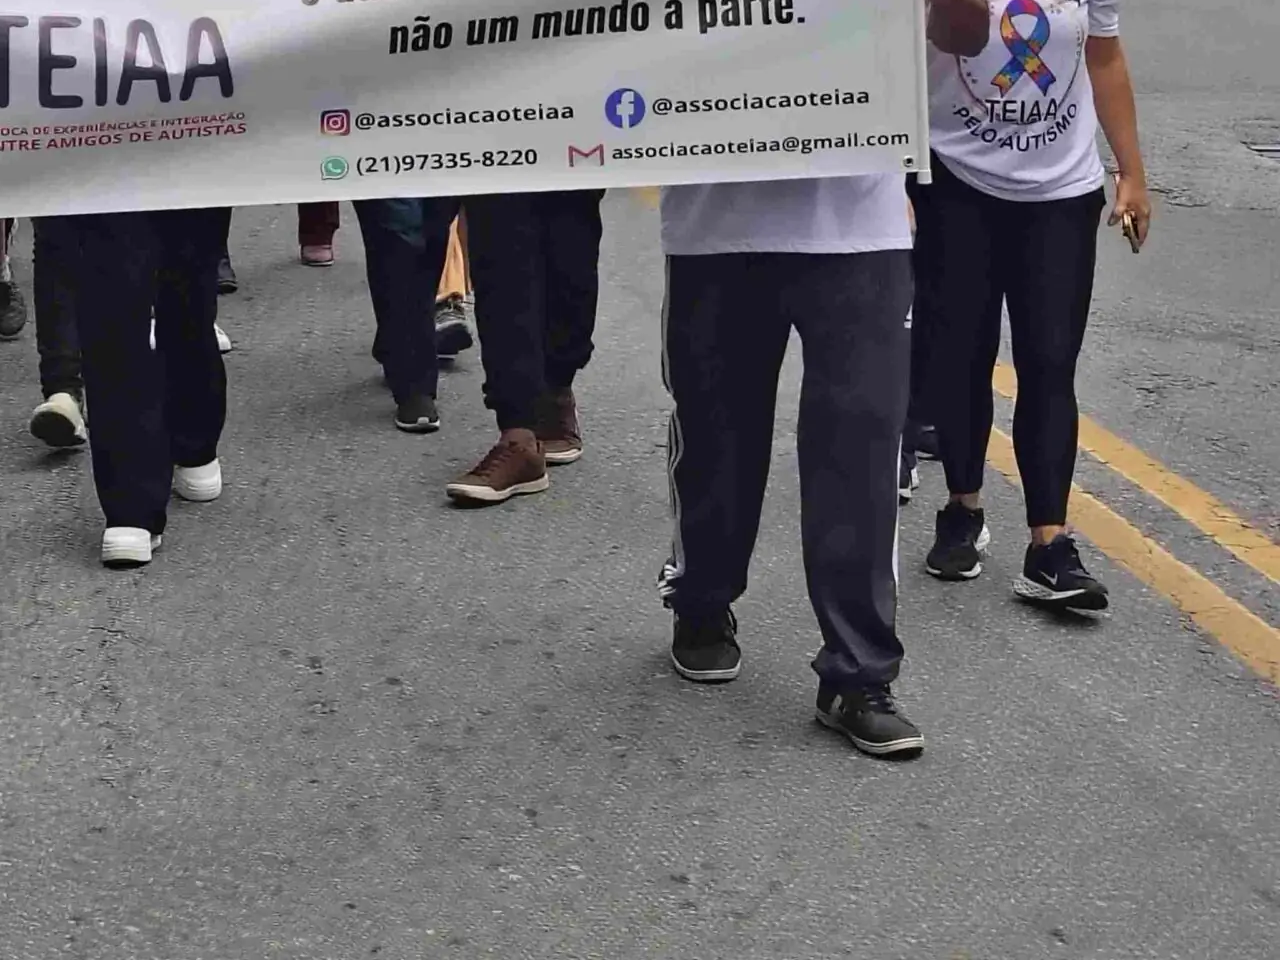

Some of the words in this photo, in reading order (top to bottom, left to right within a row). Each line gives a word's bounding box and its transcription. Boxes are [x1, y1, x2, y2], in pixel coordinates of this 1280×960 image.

[389, 16, 453, 54] não
[466, 15, 519, 46] um
[532, 0, 650, 39] mundo
[652, 88, 870, 116] @associacaoteiaa
[984, 99, 1059, 123] TEIAA
[33, 126, 49, 135] DE
[54, 120, 145, 135] EXPERIÊNCIAS
[161, 112, 245, 127] INTEGRAÇÃO
[355, 103, 574, 130] @associacaoteiaa
[953, 106, 997, 143] PELO
[1000, 103, 1077, 151] AUTISMO
[46, 135, 122, 149] AMIGOS
[130, 131, 152, 143] DE
[158, 122, 247, 141] AUTISTAS
[612, 131, 909, 160] associacaoteiaa@gmail.com
[356, 148, 538, 176] (21)97335-8220
